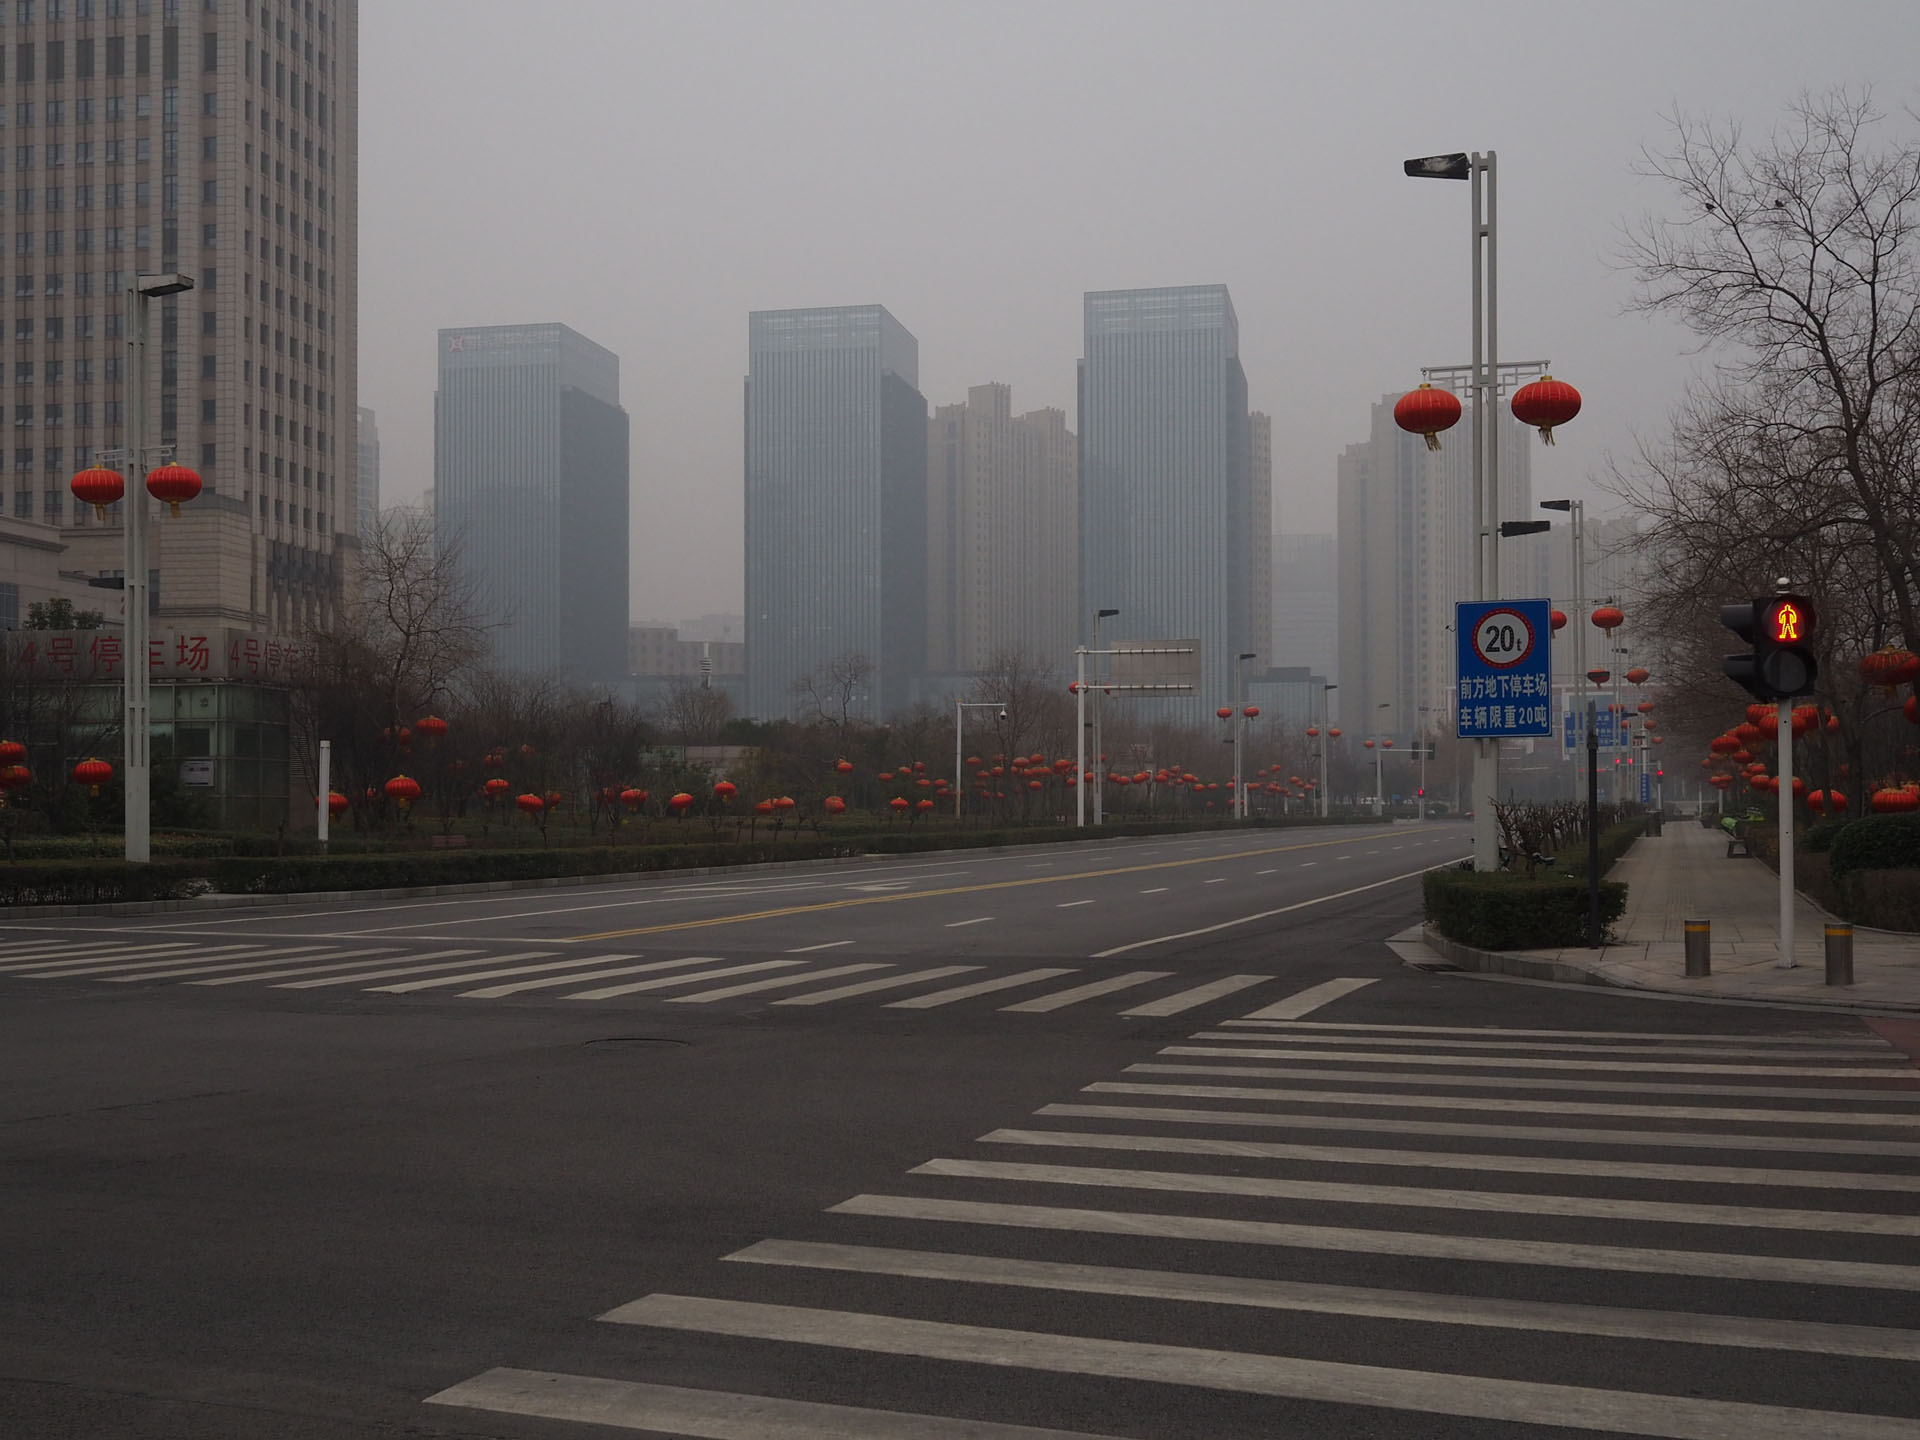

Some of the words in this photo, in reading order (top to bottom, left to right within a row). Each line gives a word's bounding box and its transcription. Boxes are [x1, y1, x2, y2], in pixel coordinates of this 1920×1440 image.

[1460, 673, 1548, 700] 前方地下停车场
[1460, 704, 1548, 729] 车辆限重20吨
